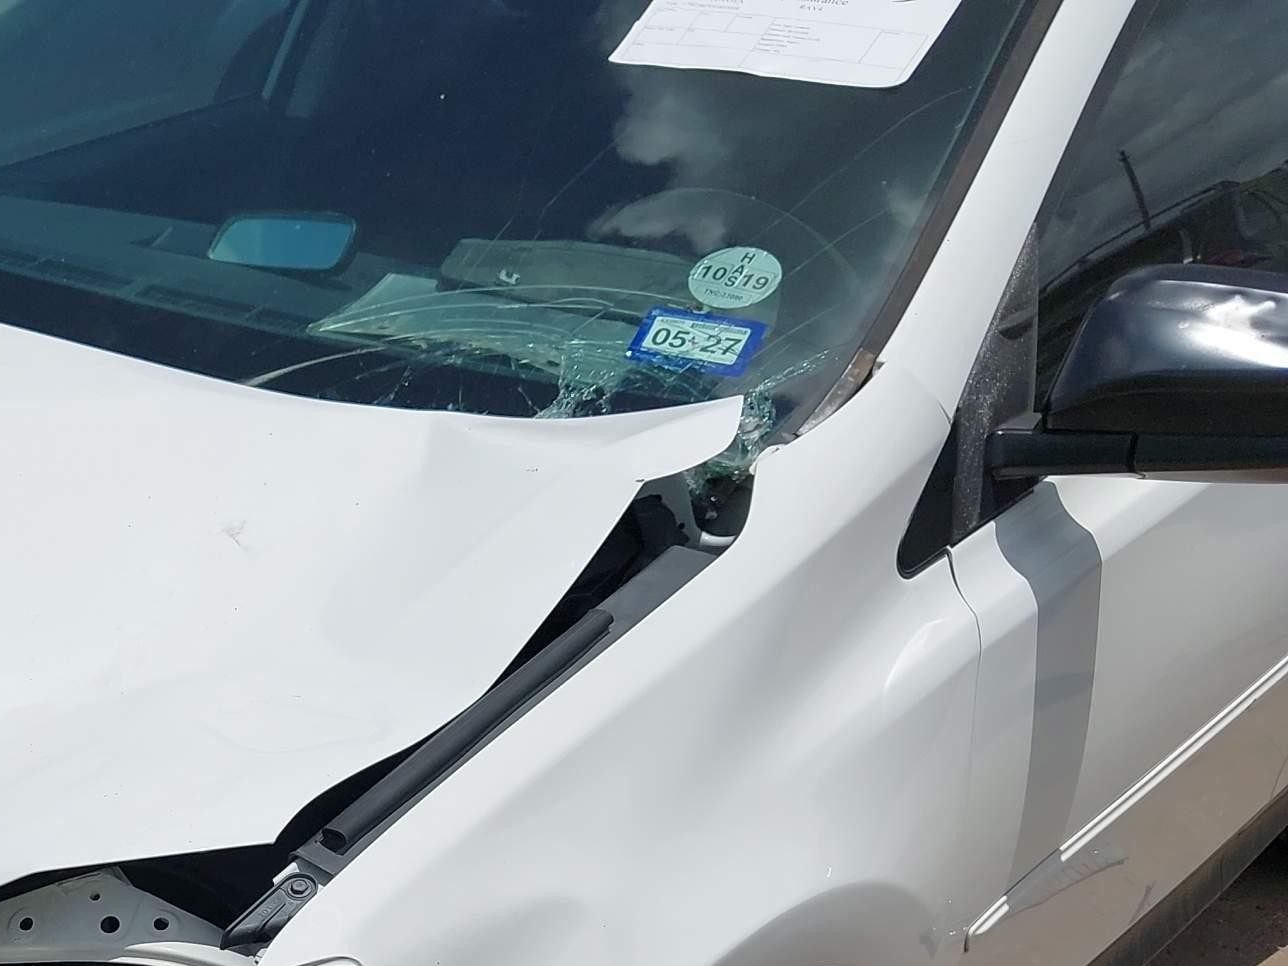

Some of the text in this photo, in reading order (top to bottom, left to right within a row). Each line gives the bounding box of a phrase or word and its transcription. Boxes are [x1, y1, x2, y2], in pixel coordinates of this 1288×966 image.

[701, 264, 769, 290] 10 19
[651, 327, 690, 349] 05
[699, 334, 743, 356] 27
